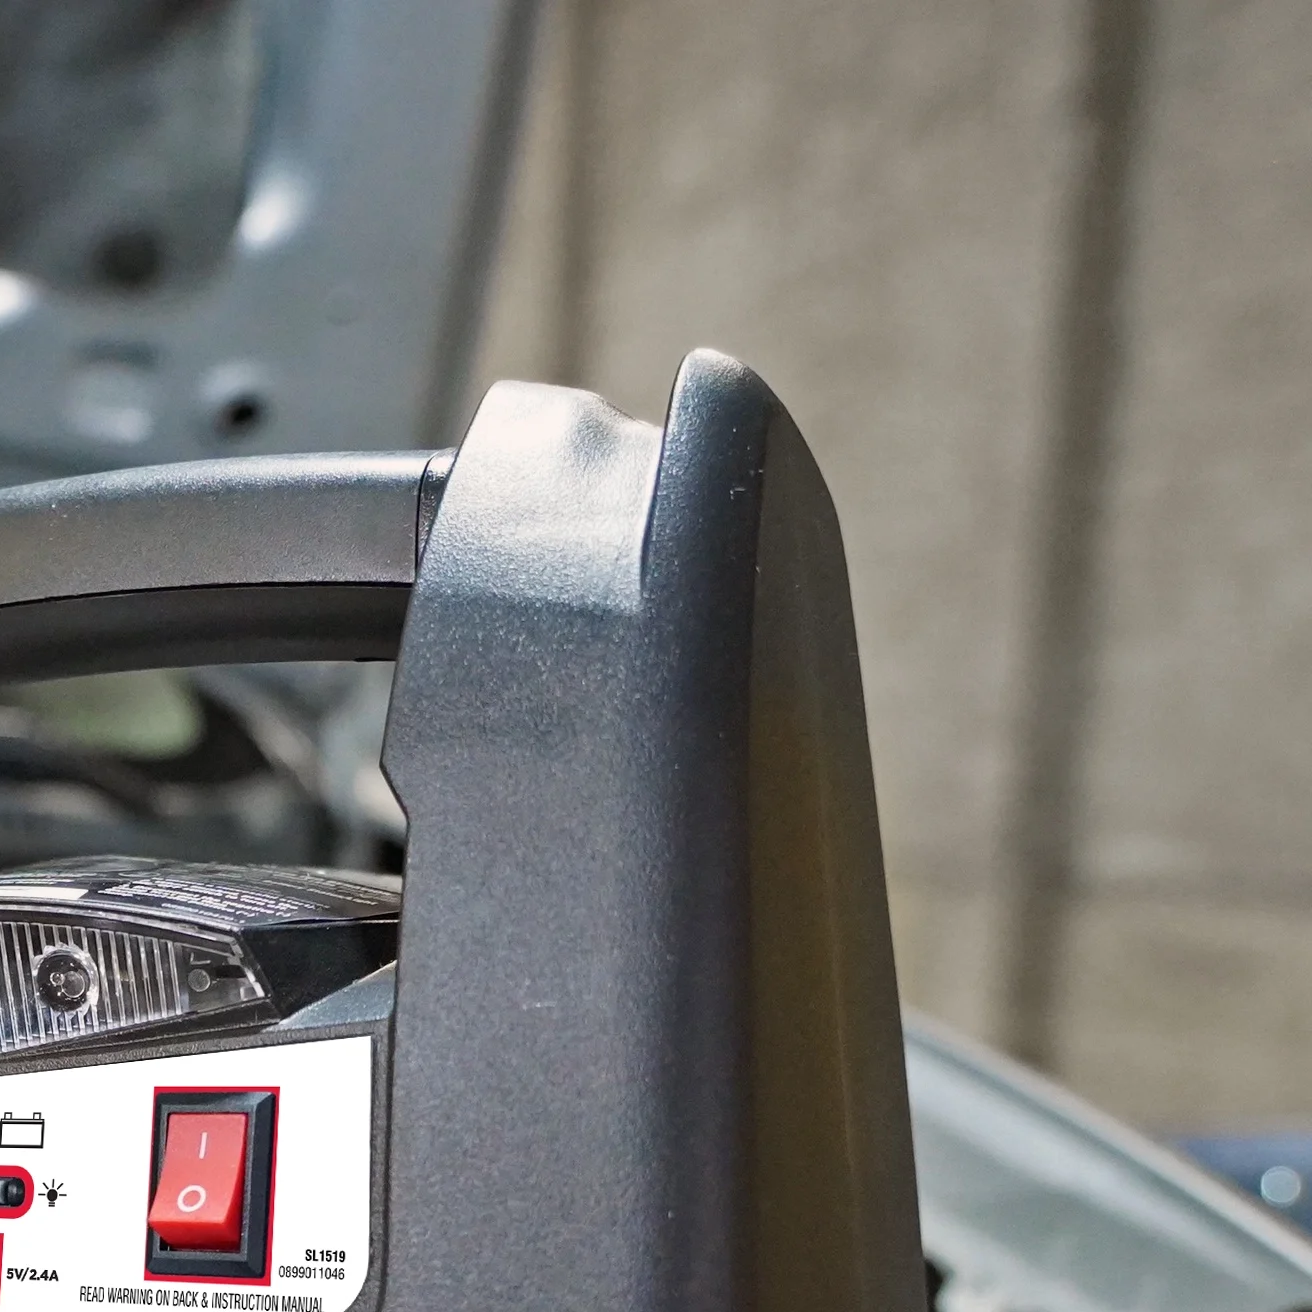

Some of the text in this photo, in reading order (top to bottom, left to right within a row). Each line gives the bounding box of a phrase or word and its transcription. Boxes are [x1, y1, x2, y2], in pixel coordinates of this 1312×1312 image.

[304, 1248, 346, 1263] SL1519
[6, 1267, 59, 1282] 5V/2.4A
[278, 1265, 345, 1281] 0899011046
[79, 1285, 105, 1303] READ
[107, 1287, 154, 1306] WARNING
[155, 1289, 171, 1307] ON
[172, 1290, 200, 1308] BACK
[201, 1291, 209, 1309] &
[211, 1293, 280, 1312] INSTRUCTION
